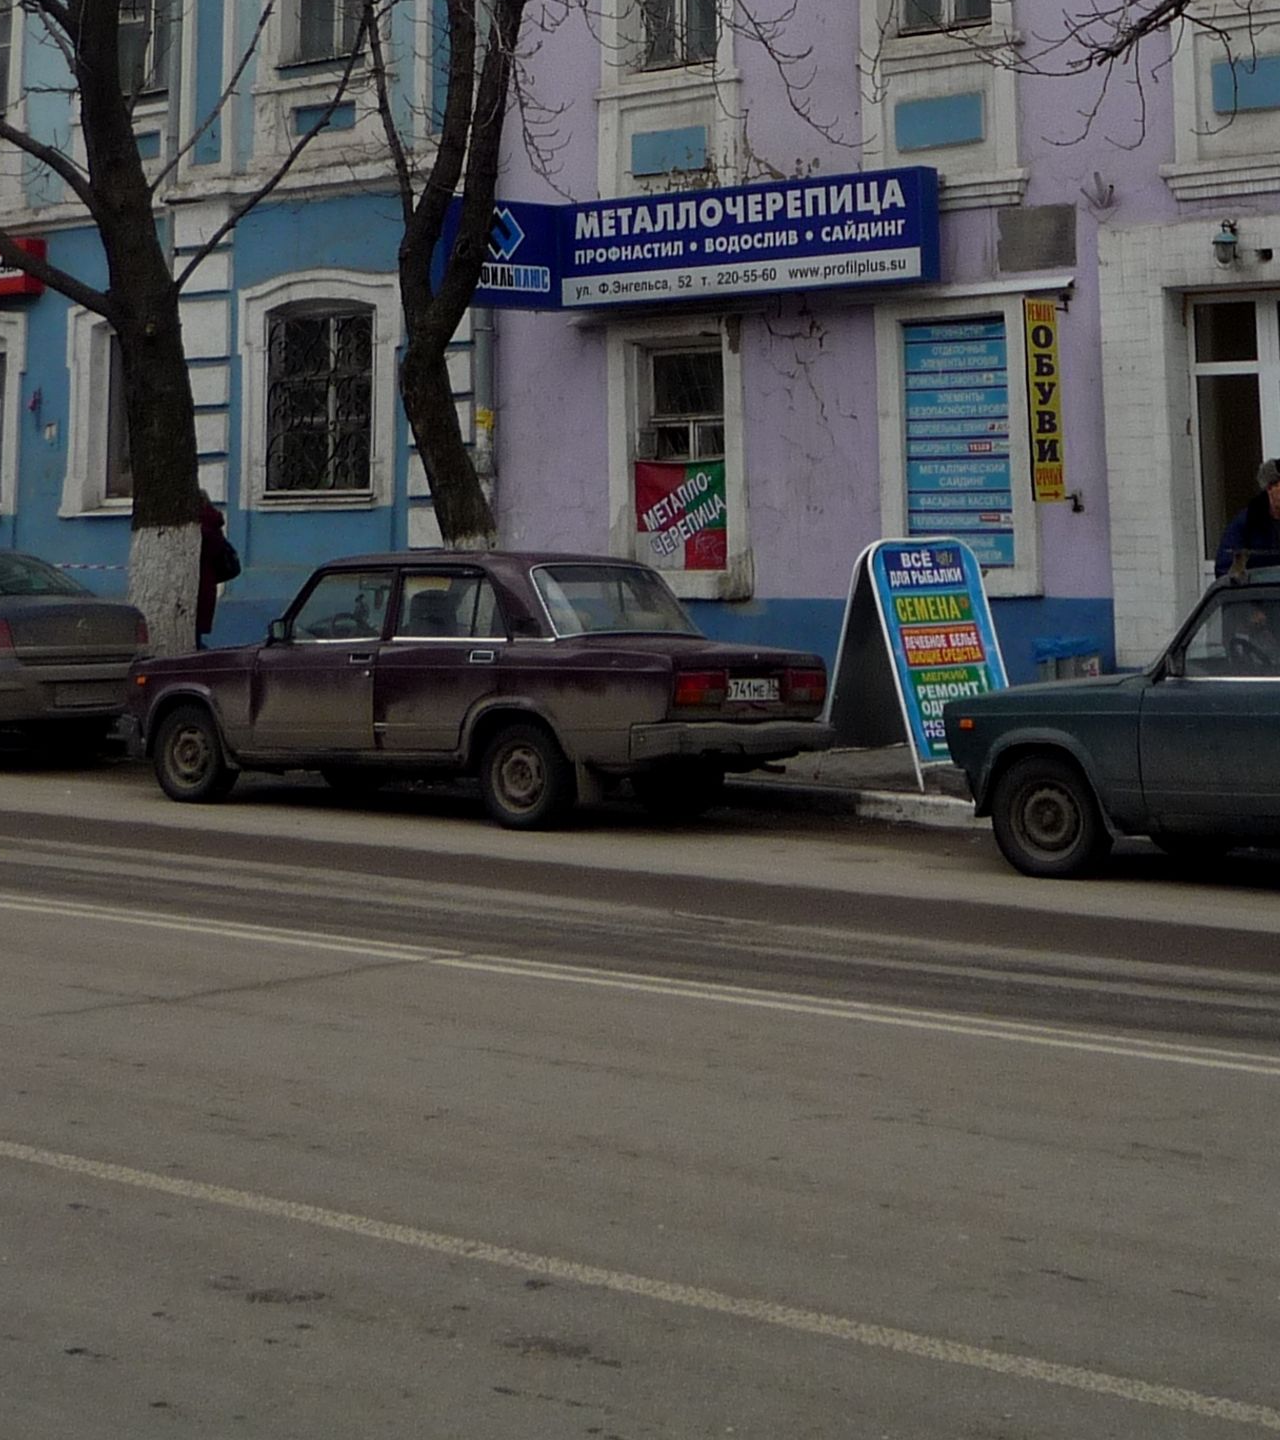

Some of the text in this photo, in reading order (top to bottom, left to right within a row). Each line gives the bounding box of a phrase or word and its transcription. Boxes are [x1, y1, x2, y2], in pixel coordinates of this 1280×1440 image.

[575, 179, 905, 241] МЕТАЛЛОЧЕРЕПИЦА
[575, 218, 906, 265] ПРОФНАСТИЛ ВОДОСЛИВ САЙДИНГ
[576, 282, 592, 299] ул.
[599, 276, 672, 296] Ф.Энгельса,
[678, 275, 693, 289] 52
[717, 268, 777, 285] 220-55-60
[789, 254, 907, 282] www.profilplus.su
[1032, 325, 1061, 462] ОБУВИ
[643, 471, 712, 532] МЕТАЛЛО-
[650, 493, 726, 556] ЧЕРЕПИЦА
[889, 567, 963, 588] ДЛЯ РЫБАЛКИ
[900, 549, 933, 568] ВСЁ
[896, 596, 962, 622] СЕМЕНА
[917, 681, 980, 700] РЕМОНТ
[921, 668, 969, 683] МЕЛКИЙ
